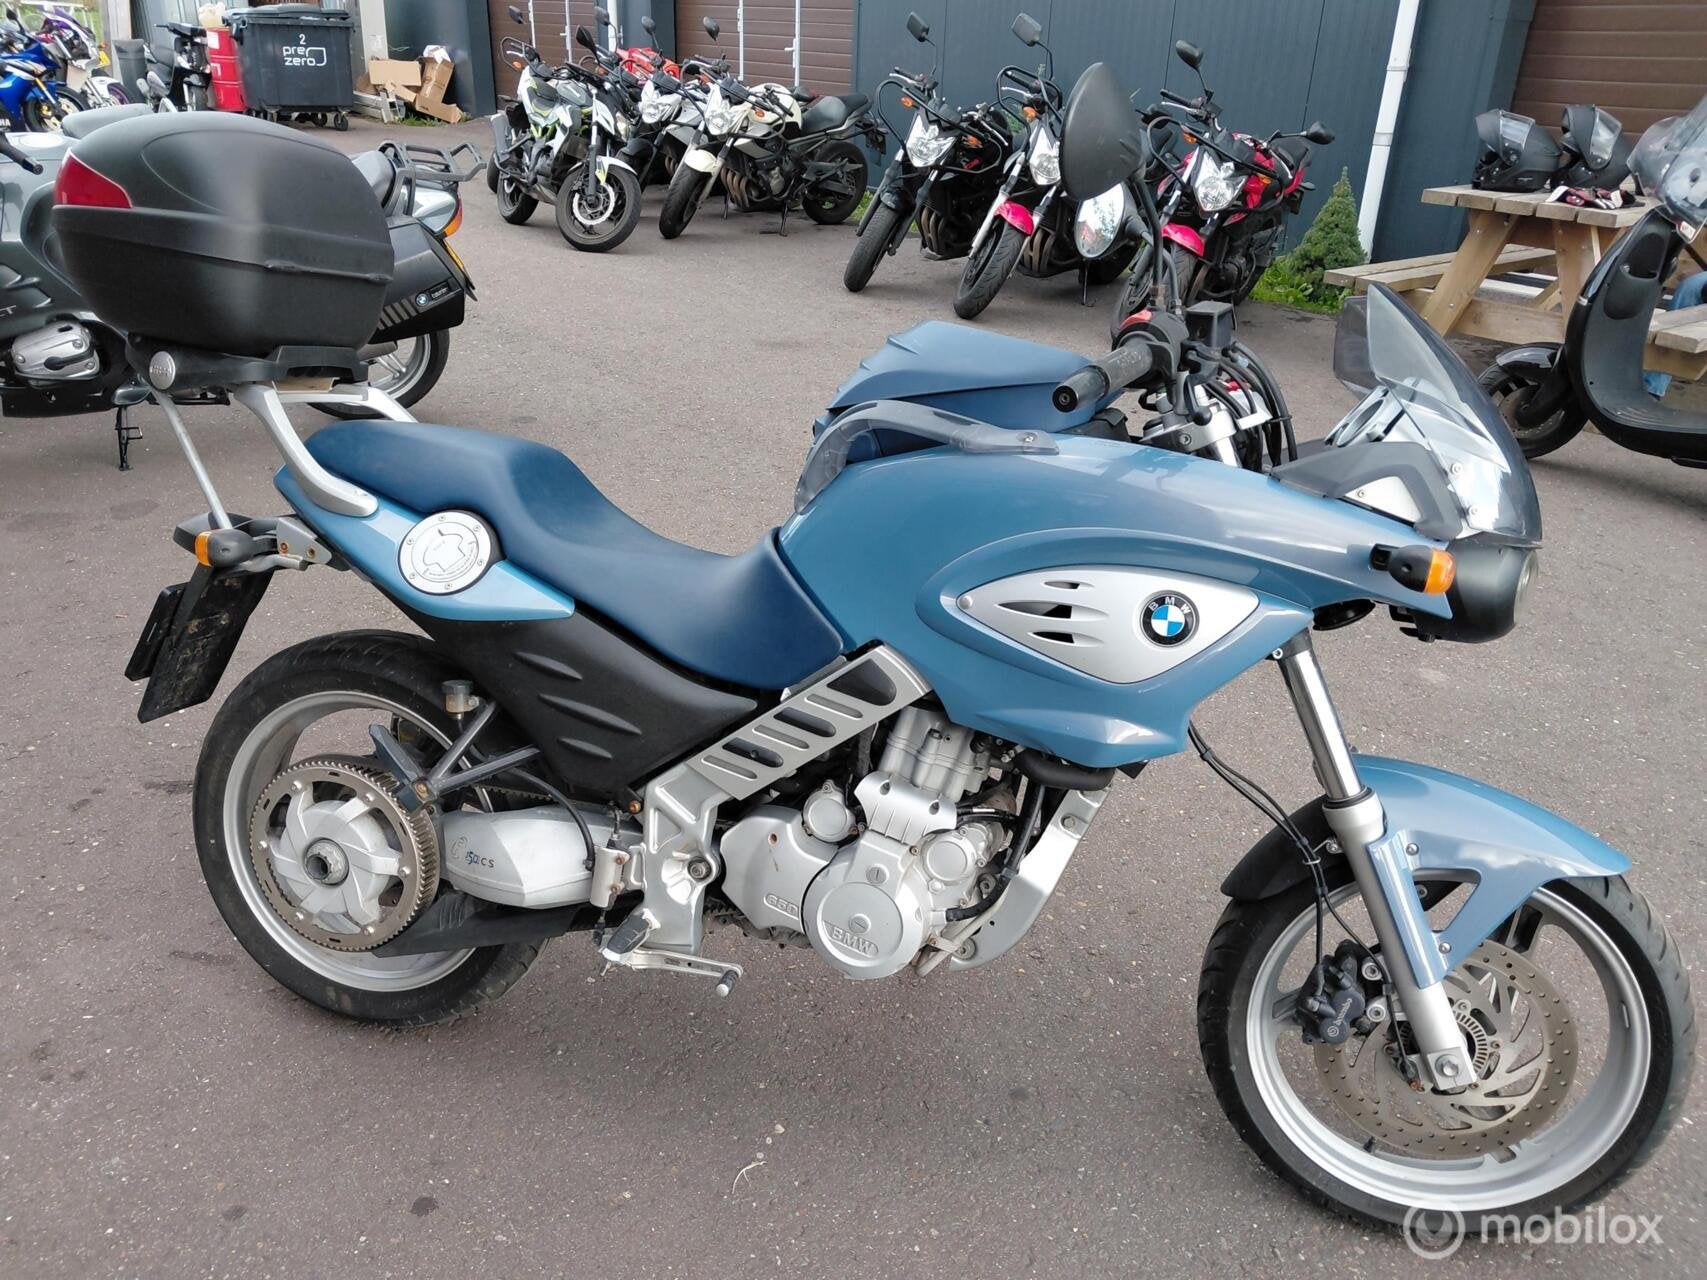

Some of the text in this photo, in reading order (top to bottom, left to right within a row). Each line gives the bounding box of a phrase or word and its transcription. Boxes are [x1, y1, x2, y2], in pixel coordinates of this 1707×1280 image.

[299, 33, 306, 45] 2
[283, 46, 306, 56] pre
[284, 57, 316, 66] zero
[1148, 596, 1191, 615] BMW
[766, 894, 799, 915] 650
[832, 926, 872, 955] BMW
